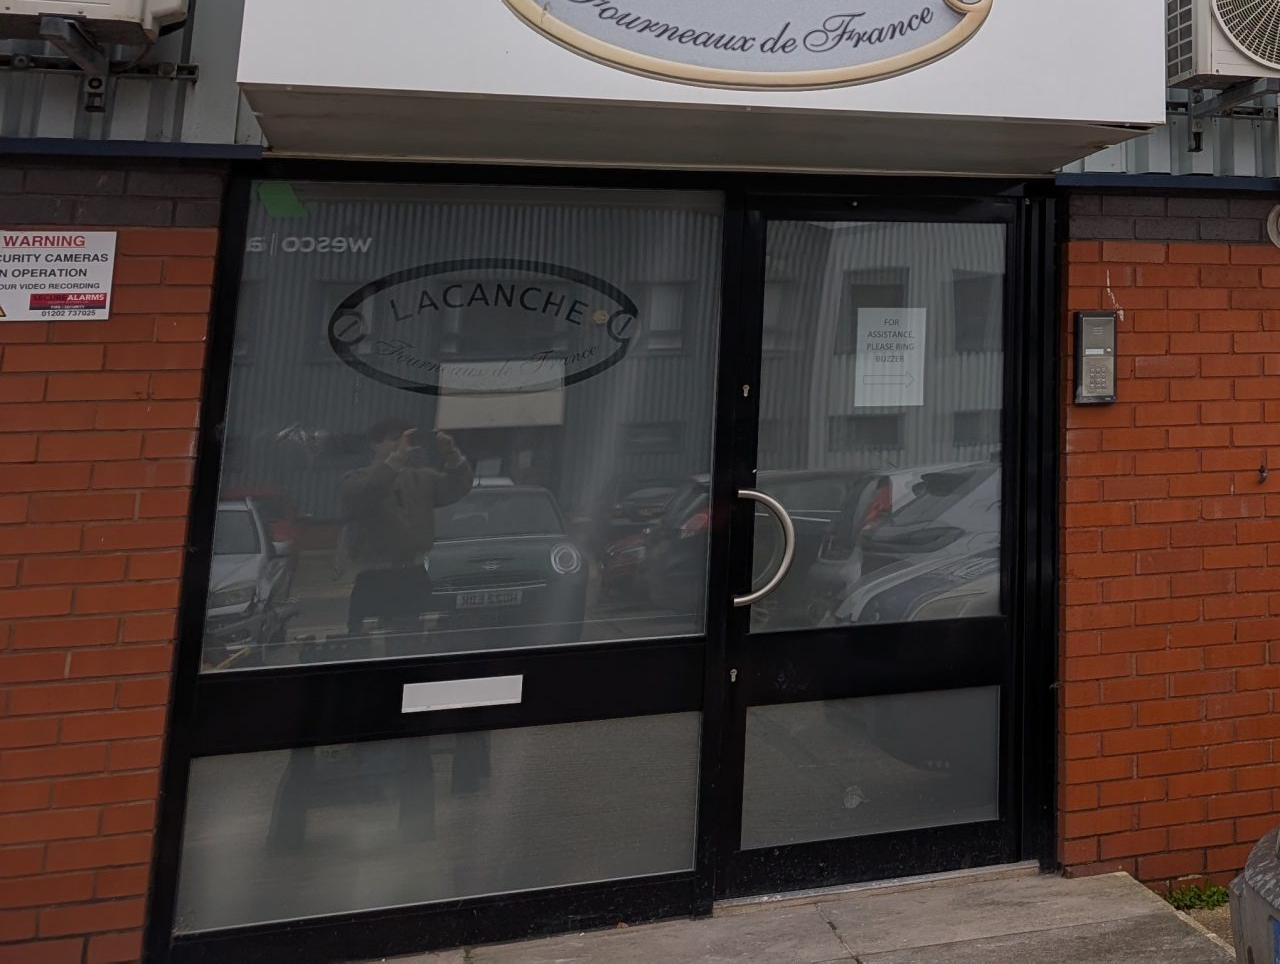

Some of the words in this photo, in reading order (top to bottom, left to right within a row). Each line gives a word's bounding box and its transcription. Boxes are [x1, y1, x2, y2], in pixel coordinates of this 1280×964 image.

[761, 21, 798, 54] de
[803, 6, 934, 50] France
[3, 235, 86, 247] WARNING
[45, 253, 108, 263] CAMERAS
[12, 268, 87, 277] OPERATION
[48, 282, 100, 290] RECORDING
[389, 283, 590, 326] LACANCHE
[67, 309, 96, 317] 737025
[884, 318, 900, 326] FOR
[866, 342, 894, 351] PLEASE
[895, 342, 914, 351] RING
[375, 339, 483, 378] Fourneaux
[520, 345, 599, 374] France
[875, 355, 905, 363] BUZZER
